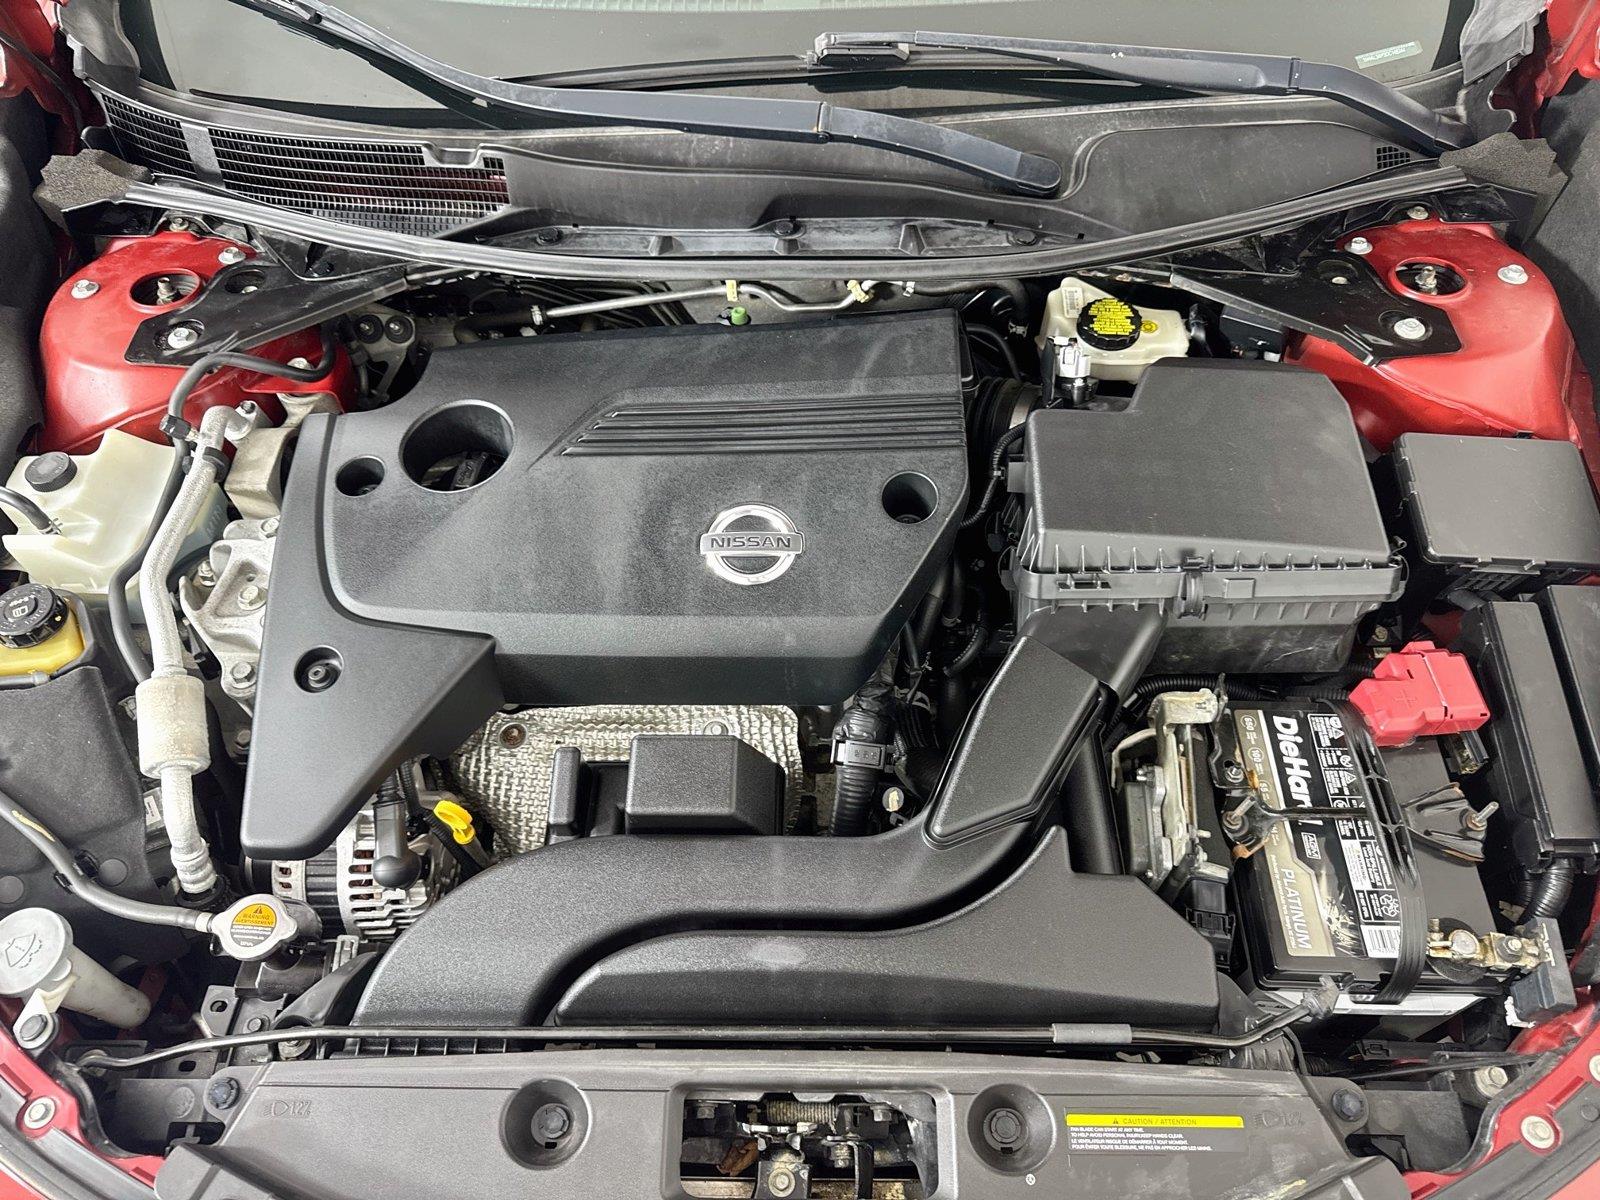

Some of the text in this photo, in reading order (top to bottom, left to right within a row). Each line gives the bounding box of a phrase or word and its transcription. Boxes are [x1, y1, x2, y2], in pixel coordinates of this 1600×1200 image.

[711, 537, 791, 548] NISSAN
[1273, 715, 1323, 825] DieHar
[1307, 835, 1319, 858] AGM
[1282, 868, 1312, 949] PLATINUM
